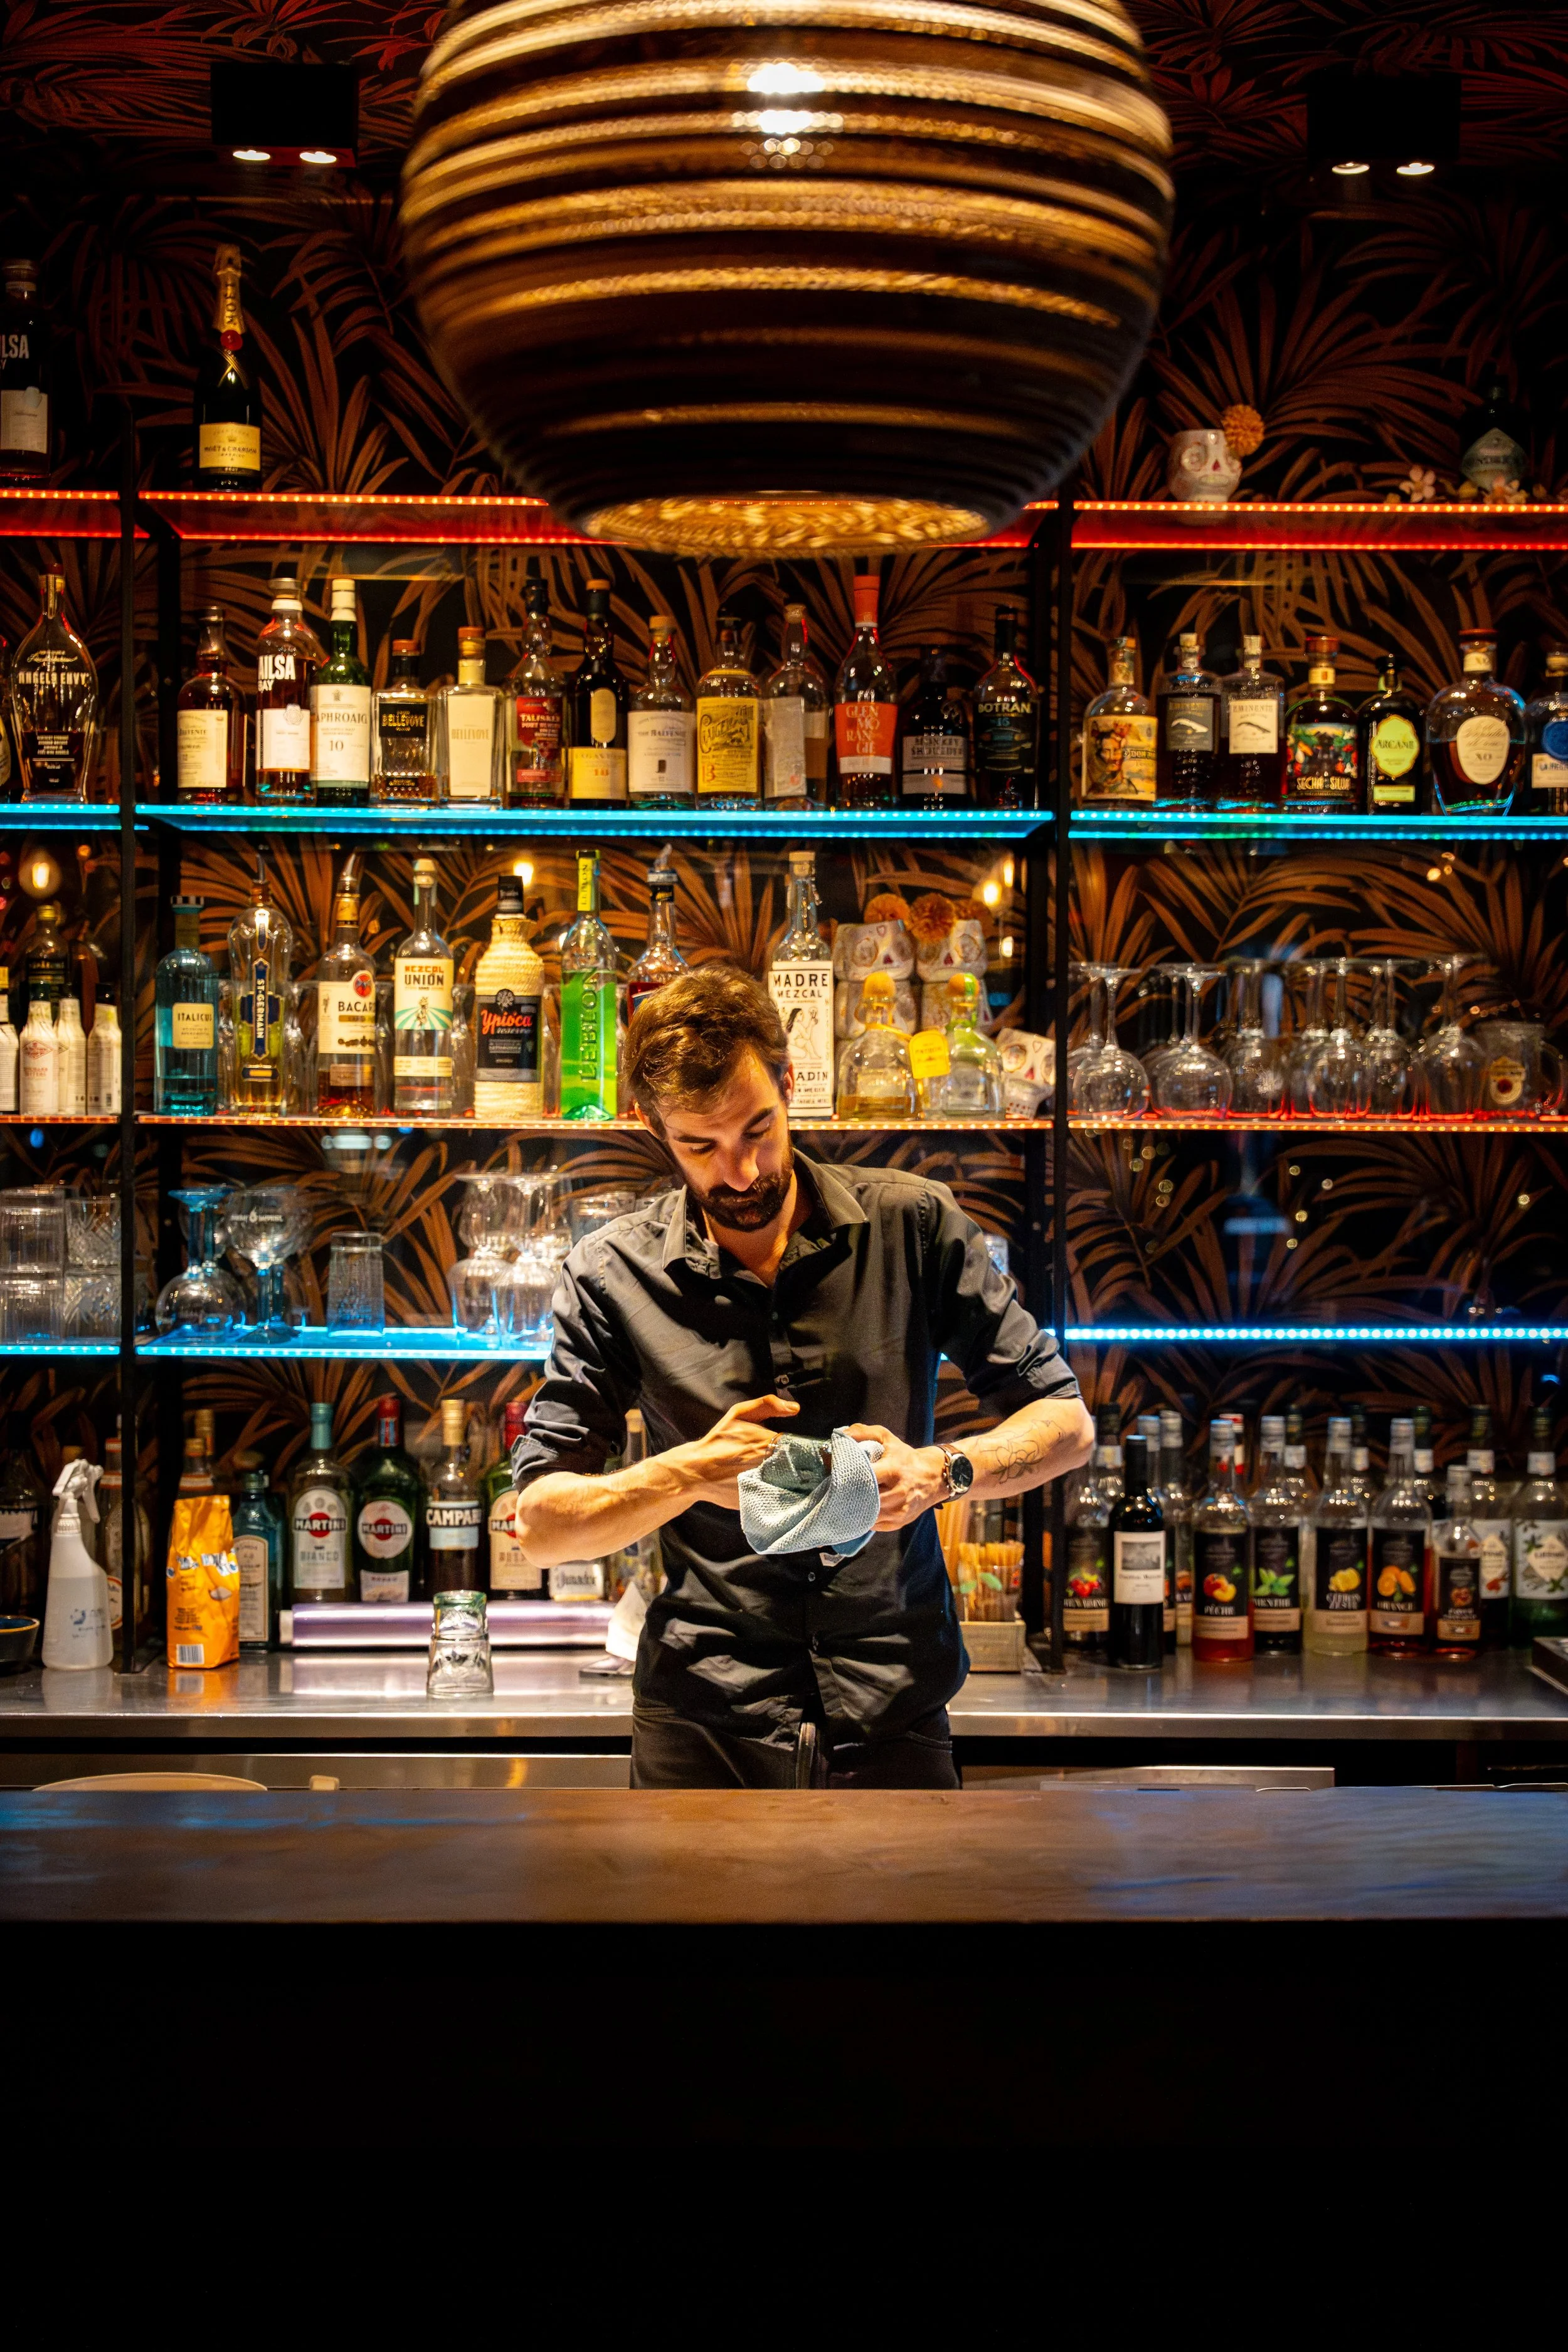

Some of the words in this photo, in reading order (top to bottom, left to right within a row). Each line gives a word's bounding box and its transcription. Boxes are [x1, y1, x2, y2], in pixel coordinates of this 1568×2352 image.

[0, 334, 29, 359] LSA
[258, 654, 295, 680] AILSA
[847, 705, 878, 718] GLEN
[978, 702, 1033, 714] BOTRAN
[330, 740, 344, 751] 10
[773, 973, 828, 987] MADRE
[777, 989, 823, 998] MEZCAL
[257, 978, 265, 1039] ST-GERMAIN
[338, 1002, 375, 1011] BACAR
[296, 1519, 346, 1530] MARTINI
[362, 1523, 406, 1534] MARTINI
